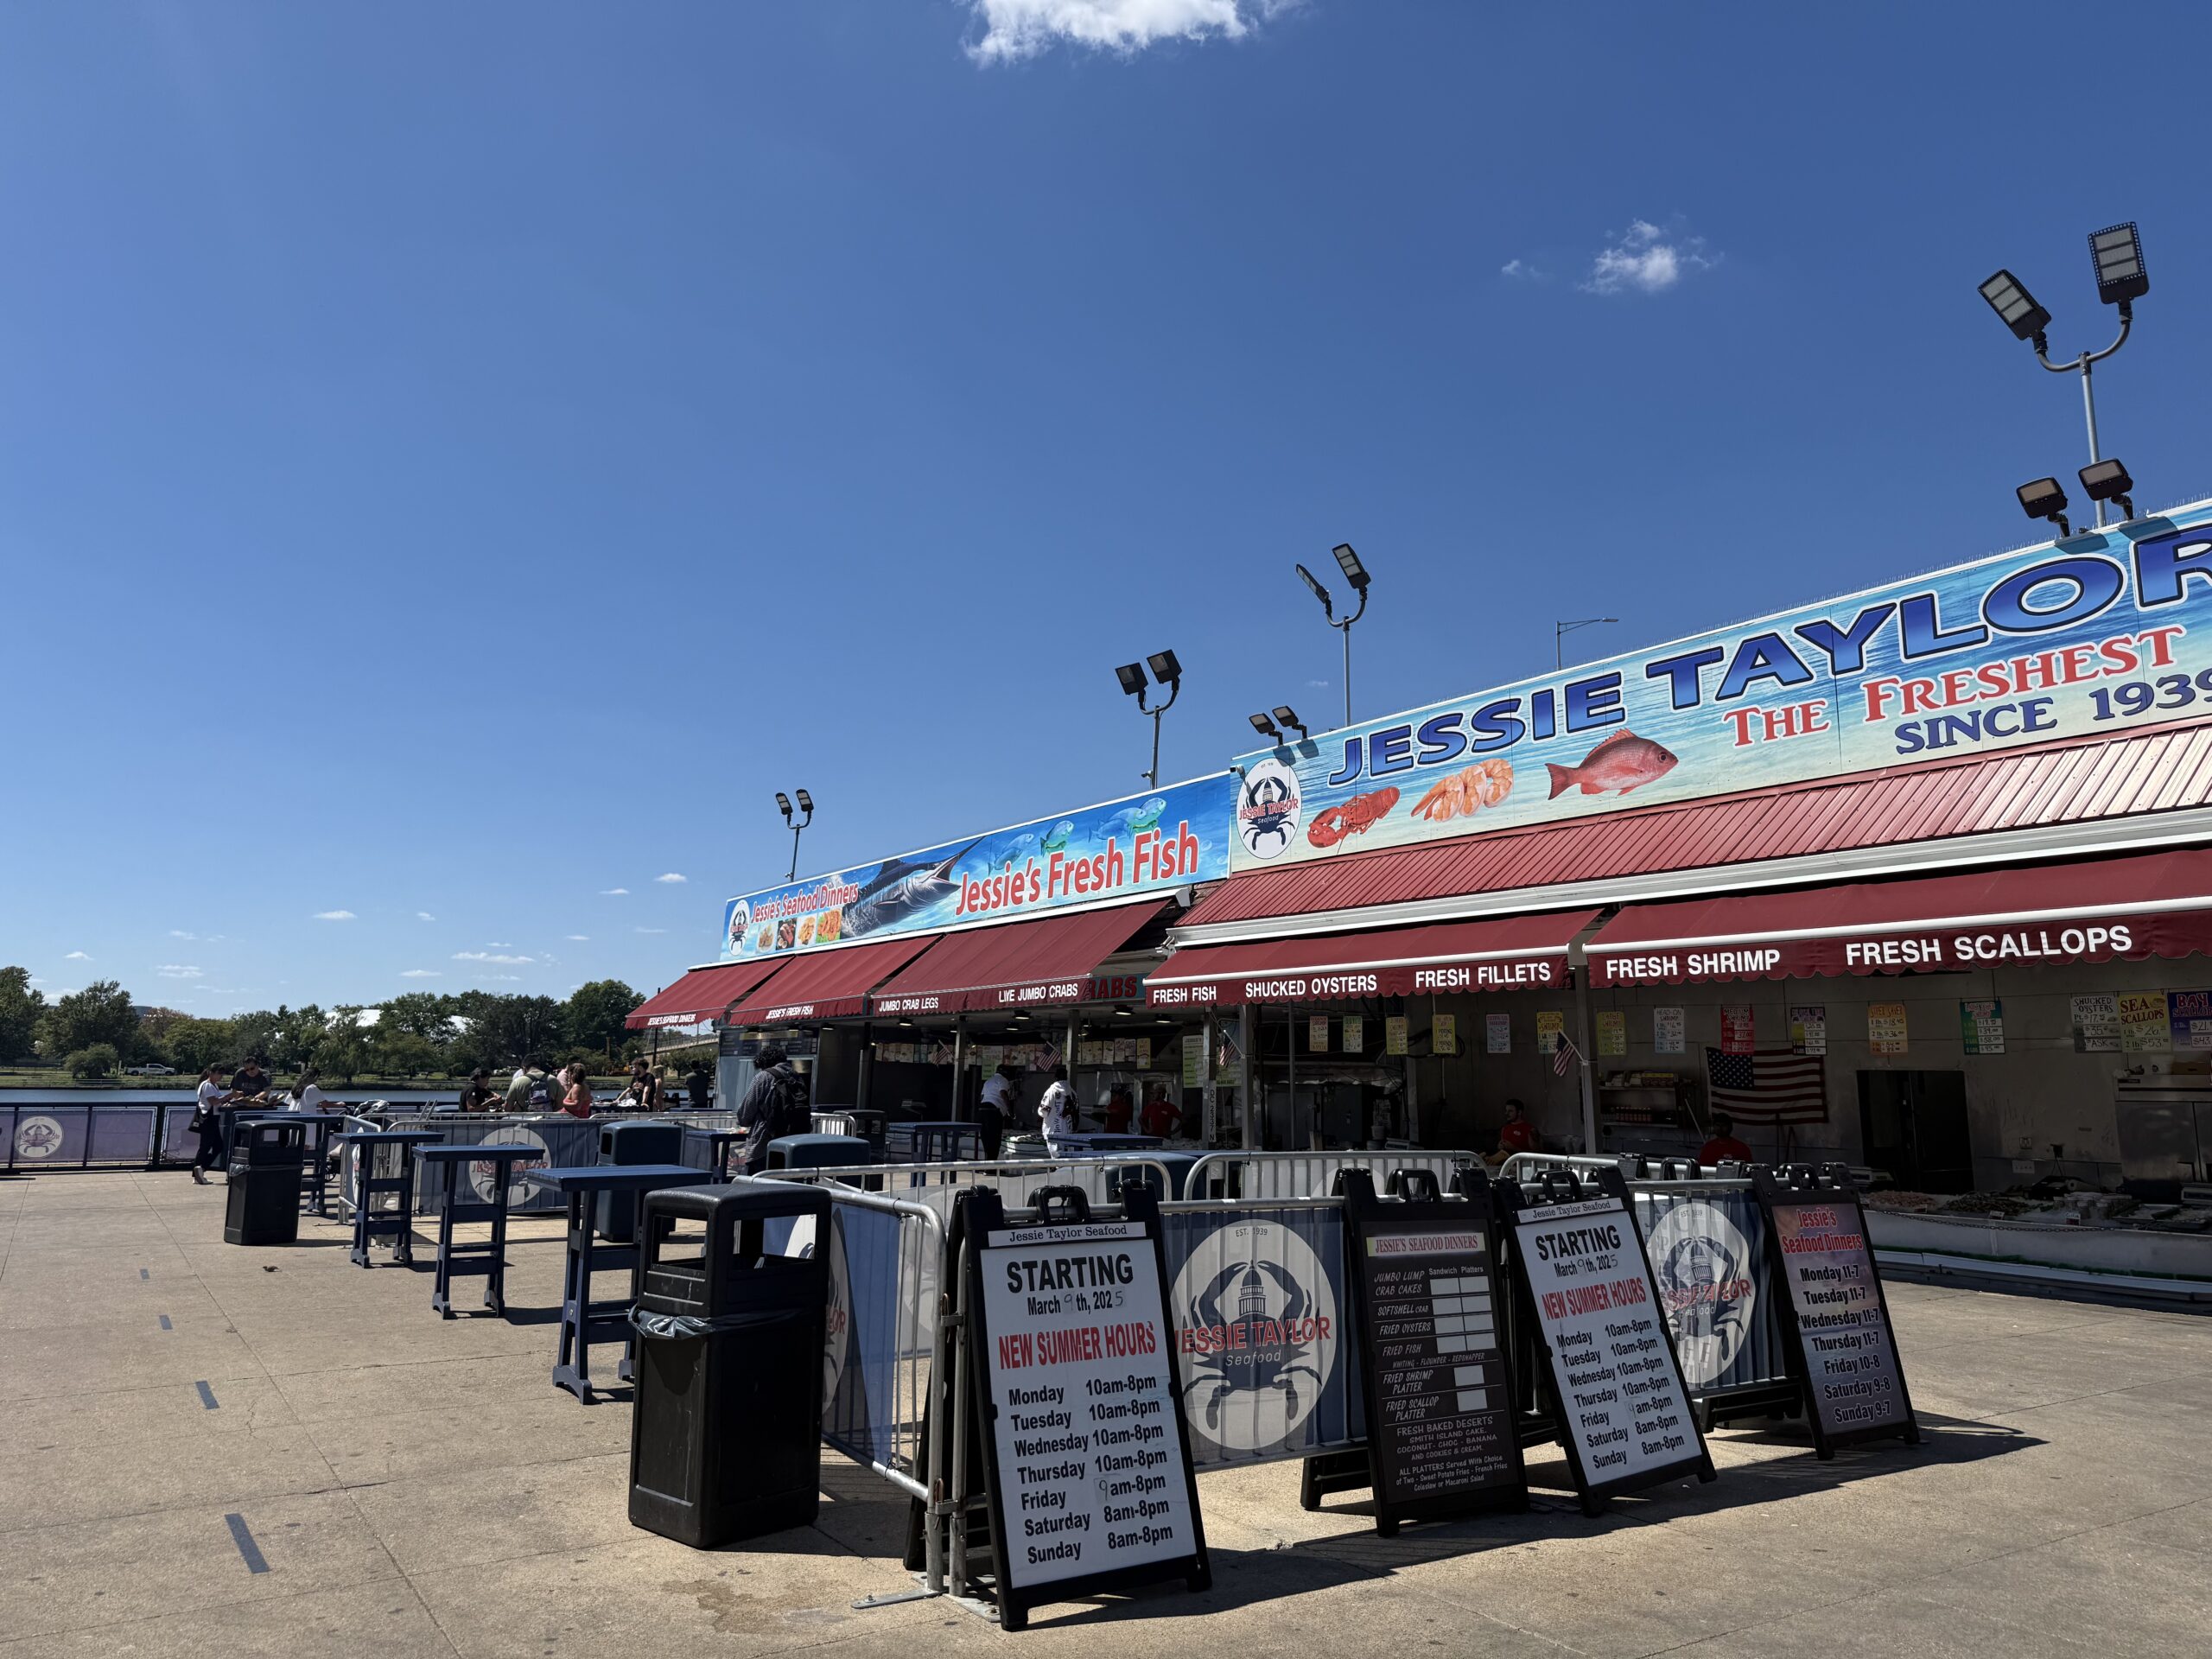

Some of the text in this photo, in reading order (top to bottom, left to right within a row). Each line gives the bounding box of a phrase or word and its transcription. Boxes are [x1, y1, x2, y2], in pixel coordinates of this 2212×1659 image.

[1327, 522, 2212, 788] JESSIE TAYLOR
[1723, 624, 2186, 747] THE FRESHEST
[1894, 665, 2212, 755] SINCE 1939
[1239, 798, 1299, 820] JESSIE TAYLOR
[1257, 815, 1279, 824] Seafood
[955, 820, 1199, 918] Jessie's Fresh Fish
[751, 883, 859, 923] Jessie's Seafood Dinners
[1846, 925, 2133, 966] FRESH SCALLOPS
[1414, 962, 1551, 988] FRESH FILLETS
[1605, 950, 1780, 980] FRESH SHRIMP
[999, 983, 1078, 1002] LIVE JUMBO CRABS
[1154, 986, 1217, 1003] FRESH FISH
[1245, 975, 1377, 999] SHUCKED OYSTERS
[879, 1001, 900, 1012] JUMBO
[902, 999, 919, 1010] CRAB
[921, 997, 938, 1008] LEGS
[2074, 996, 2112, 1007] SHUCKED
[2079, 1004, 2113, 1014] OYSTERS
[2120, 997, 2150, 1014] SEA
[2177, 993, 2209, 1007] BAY
[2120, 1009, 2164, 1025] SCALLOPS
[1533, 1201, 1611, 1218] Jessie Taylor Seafood
[1797, 1207, 1837, 1228] Jessie's
[1009, 1225, 1127, 1243] Jessie Taylor Seafood
[1236, 1228, 1249, 1237] EST.
[1535, 1225, 1621, 1261] STARTING
[1782, 1232, 1864, 1254] Seafood Dinners
[1376, 1235, 1478, 1253] JESSIE'S SEAFOOD DINNERS
[1007, 1254, 1134, 1294] STARTING
[1374, 1271, 1425, 1283] JUMBO LUMP
[1429, 1267, 1457, 1275] Sandwich
[1554, 1262, 1578, 1278] March
[1599, 1255, 1618, 1270] 2025
[1799, 1264, 1859, 1282] Monday 11-7
[1376, 1284, 1422, 1296] CRAB CAKES
[1541, 1277, 1647, 1320] NEW SUMMER HOURS
[1802, 1286, 1866, 1306] Tuesday 11-7
[1027, 1295, 1061, 1316] March
[1094, 1291, 1123, 1310] 2025
[1377, 1305, 1414, 1316] SOFTSHELL
[1380, 1322, 1431, 1336] FRIED OYSTERS
[1800, 1308, 1879, 1329] Wednesday 11-7
[1251, 1316, 1332, 1347] TAYLOR
[1556, 1319, 1652, 1348] Monday 10am-8pm
[1811, 1332, 1879, 1351] Thursday 11-7
[999, 1321, 1156, 1370] NEW SUMMER HOURS
[1382, 1344, 1421, 1357] FRIED FISH
[1561, 1338, 1658, 1368] Tuesday 10am-8pm
[1226, 1349, 1281, 1367] Seafood
[1823, 1354, 1880, 1375] Friday 10-8
[1382, 1370, 1433, 1384] FRIED SHRIMP
[1567, 1357, 1664, 1388] Wednesday 10am-8pm
[1009, 1375, 1156, 1406] Monday 10am-8pm
[1393, 1382, 1422, 1395] PLATTER
[1573, 1376, 1670, 1408] Thursday 10am-8pm
[1824, 1376, 1891, 1400] Saturday 9-8
[1386, 1396, 1439, 1412] FRIED SCALLOP
[1395, 1408, 1426, 1421] PLATTER
[1834, 1401, 1891, 1423] Sunday 9-7
[1011, 1399, 1160, 1431] Tuesday 10am-8pm
[1580, 1411, 1610, 1428] Friday
[1397, 1416, 1493, 1437] FRESH BAKED DESERTS
[1409, 1434, 1434, 1444] SMITH
[1436, 1430, 1463, 1440] ISLAND
[1586, 1414, 1679, 1448] Saturday 8am-8pm
[1014, 1424, 1164, 1457] Wednesday 10am-8pm
[1466, 1434, 1497, 1444] BANANA
[1592, 1433, 1685, 1469] Sunday 8am-8pm
[1018, 1449, 1167, 1484] Thursday 10am-8pm
[1413, 1462, 1444, 1473] PLATTERS
[1446, 1460, 1467, 1469] Served
[1021, 1490, 1066, 1510] Friday
[1025, 1498, 1170, 1536] Saturday 8am-8pm
[1027, 1525, 1173, 1564] Sunday 8am-8pm
